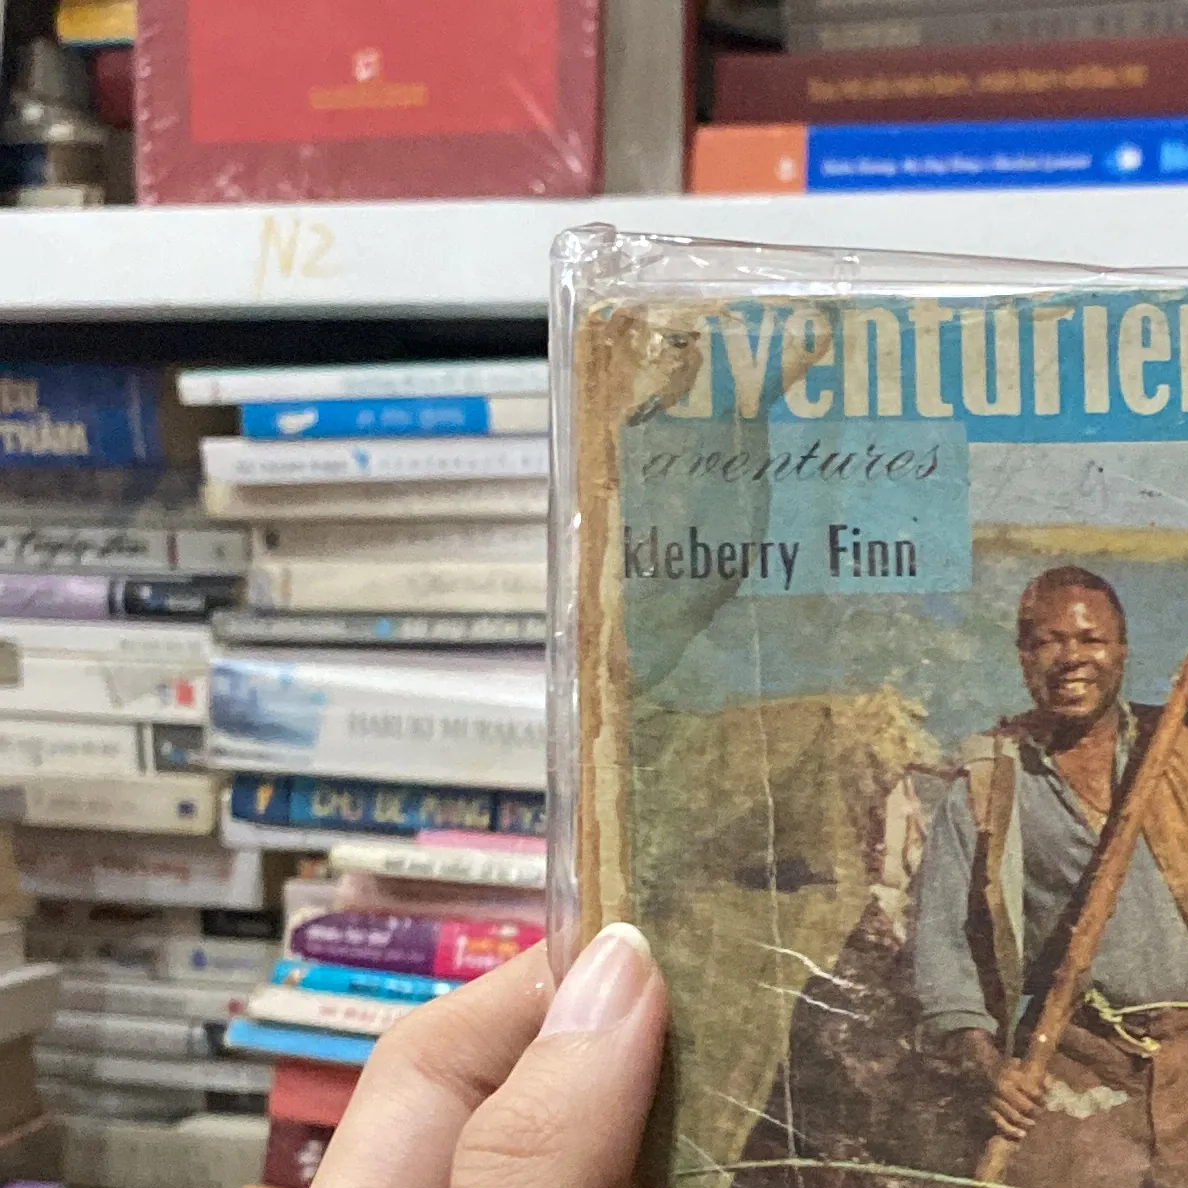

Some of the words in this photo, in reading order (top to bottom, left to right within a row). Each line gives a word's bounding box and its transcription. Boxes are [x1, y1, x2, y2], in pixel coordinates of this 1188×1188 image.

[252, 214, 337, 299] N2
[641, 439, 940, 484] aventures
[829, 524, 917, 578] Finn
